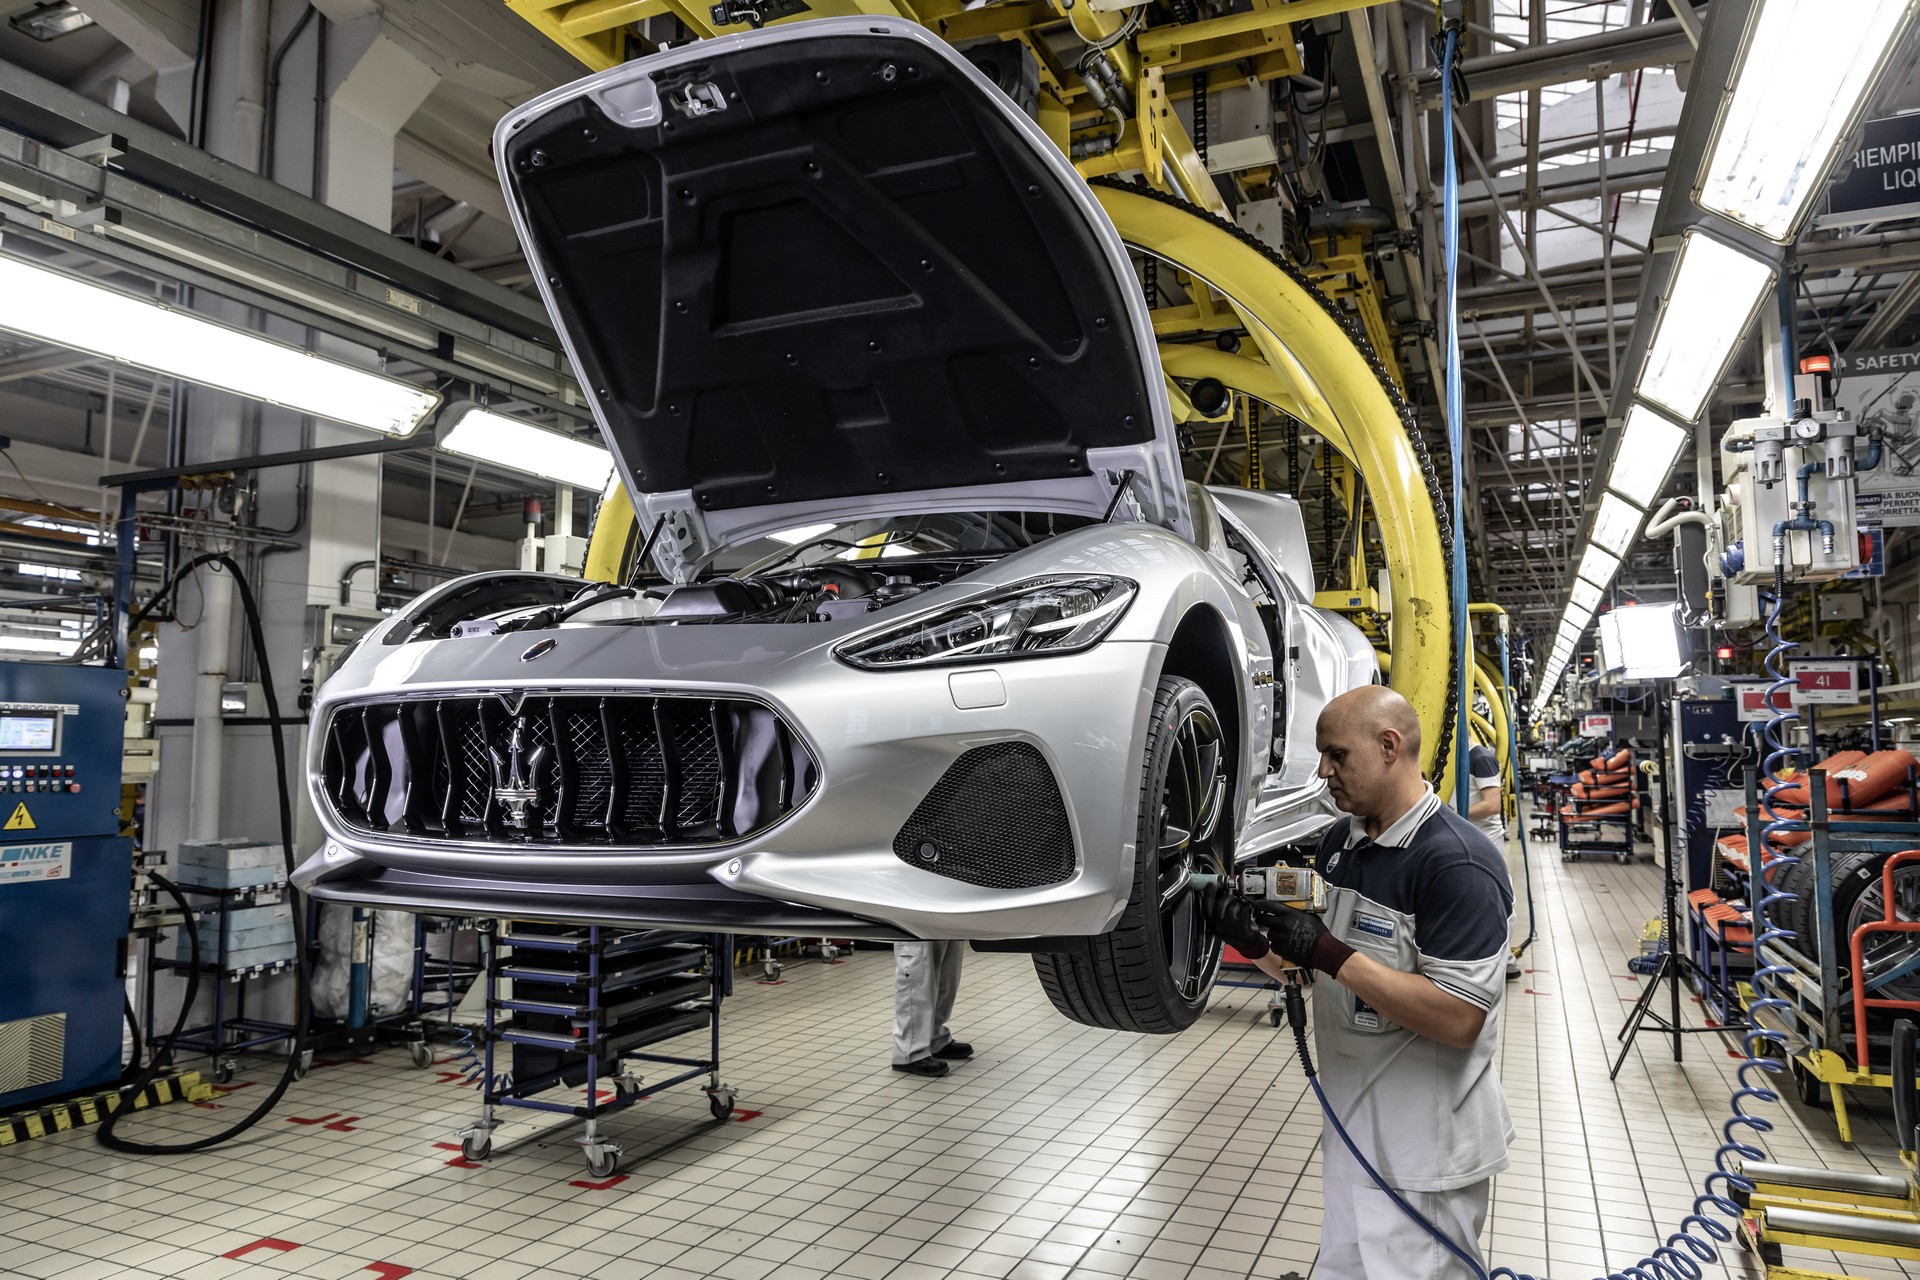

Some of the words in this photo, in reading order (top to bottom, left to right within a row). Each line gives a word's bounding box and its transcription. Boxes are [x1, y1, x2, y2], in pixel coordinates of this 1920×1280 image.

[1853, 141, 1920, 169] RIEMPI
[1856, 353, 1920, 370] SAFETY
[1880, 506, 1920, 516] ORRETTA
[1816, 674, 1830, 687] 41
